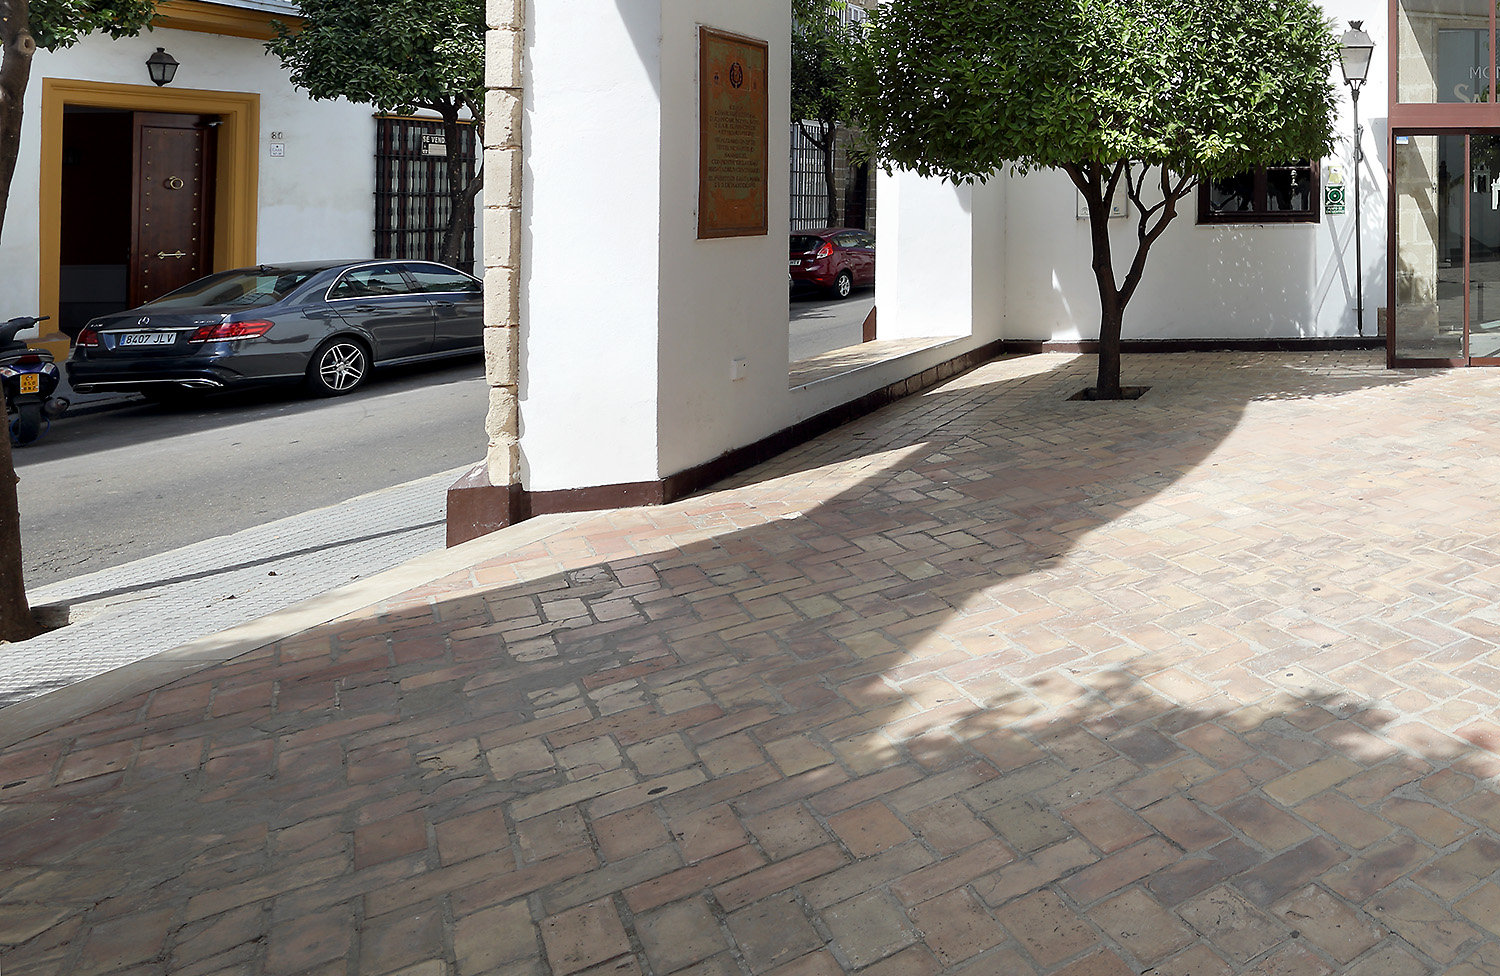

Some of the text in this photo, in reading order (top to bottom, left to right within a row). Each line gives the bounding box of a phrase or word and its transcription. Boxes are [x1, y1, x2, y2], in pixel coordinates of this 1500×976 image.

[422, 135, 446, 144] SE VEND
[126, 334, 174, 344] 8407 JLV
